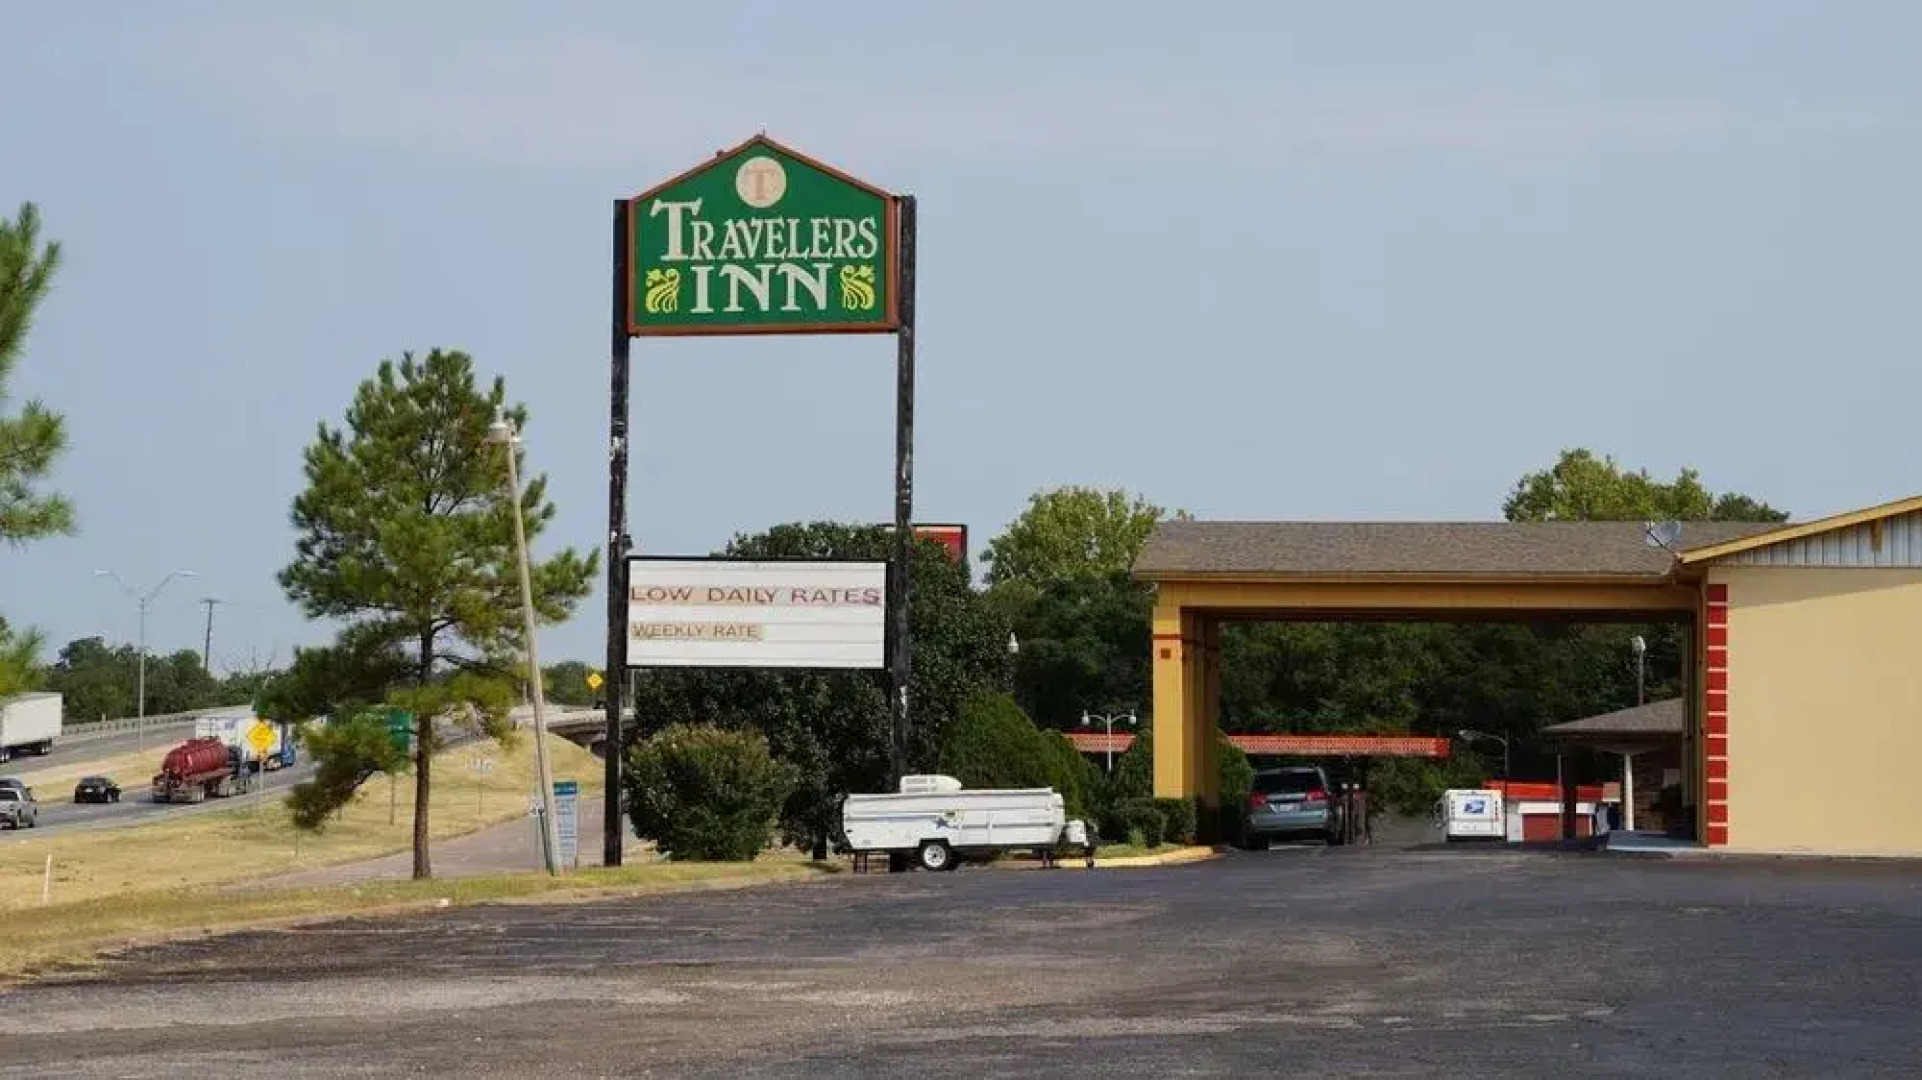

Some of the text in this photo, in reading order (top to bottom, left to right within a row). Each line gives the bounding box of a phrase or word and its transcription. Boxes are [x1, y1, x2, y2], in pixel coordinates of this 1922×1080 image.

[690, 263, 833, 313] INN
[631, 587, 880, 604] LOW DAILY RATES
[632, 624, 758, 638] WEEKLY RATE
